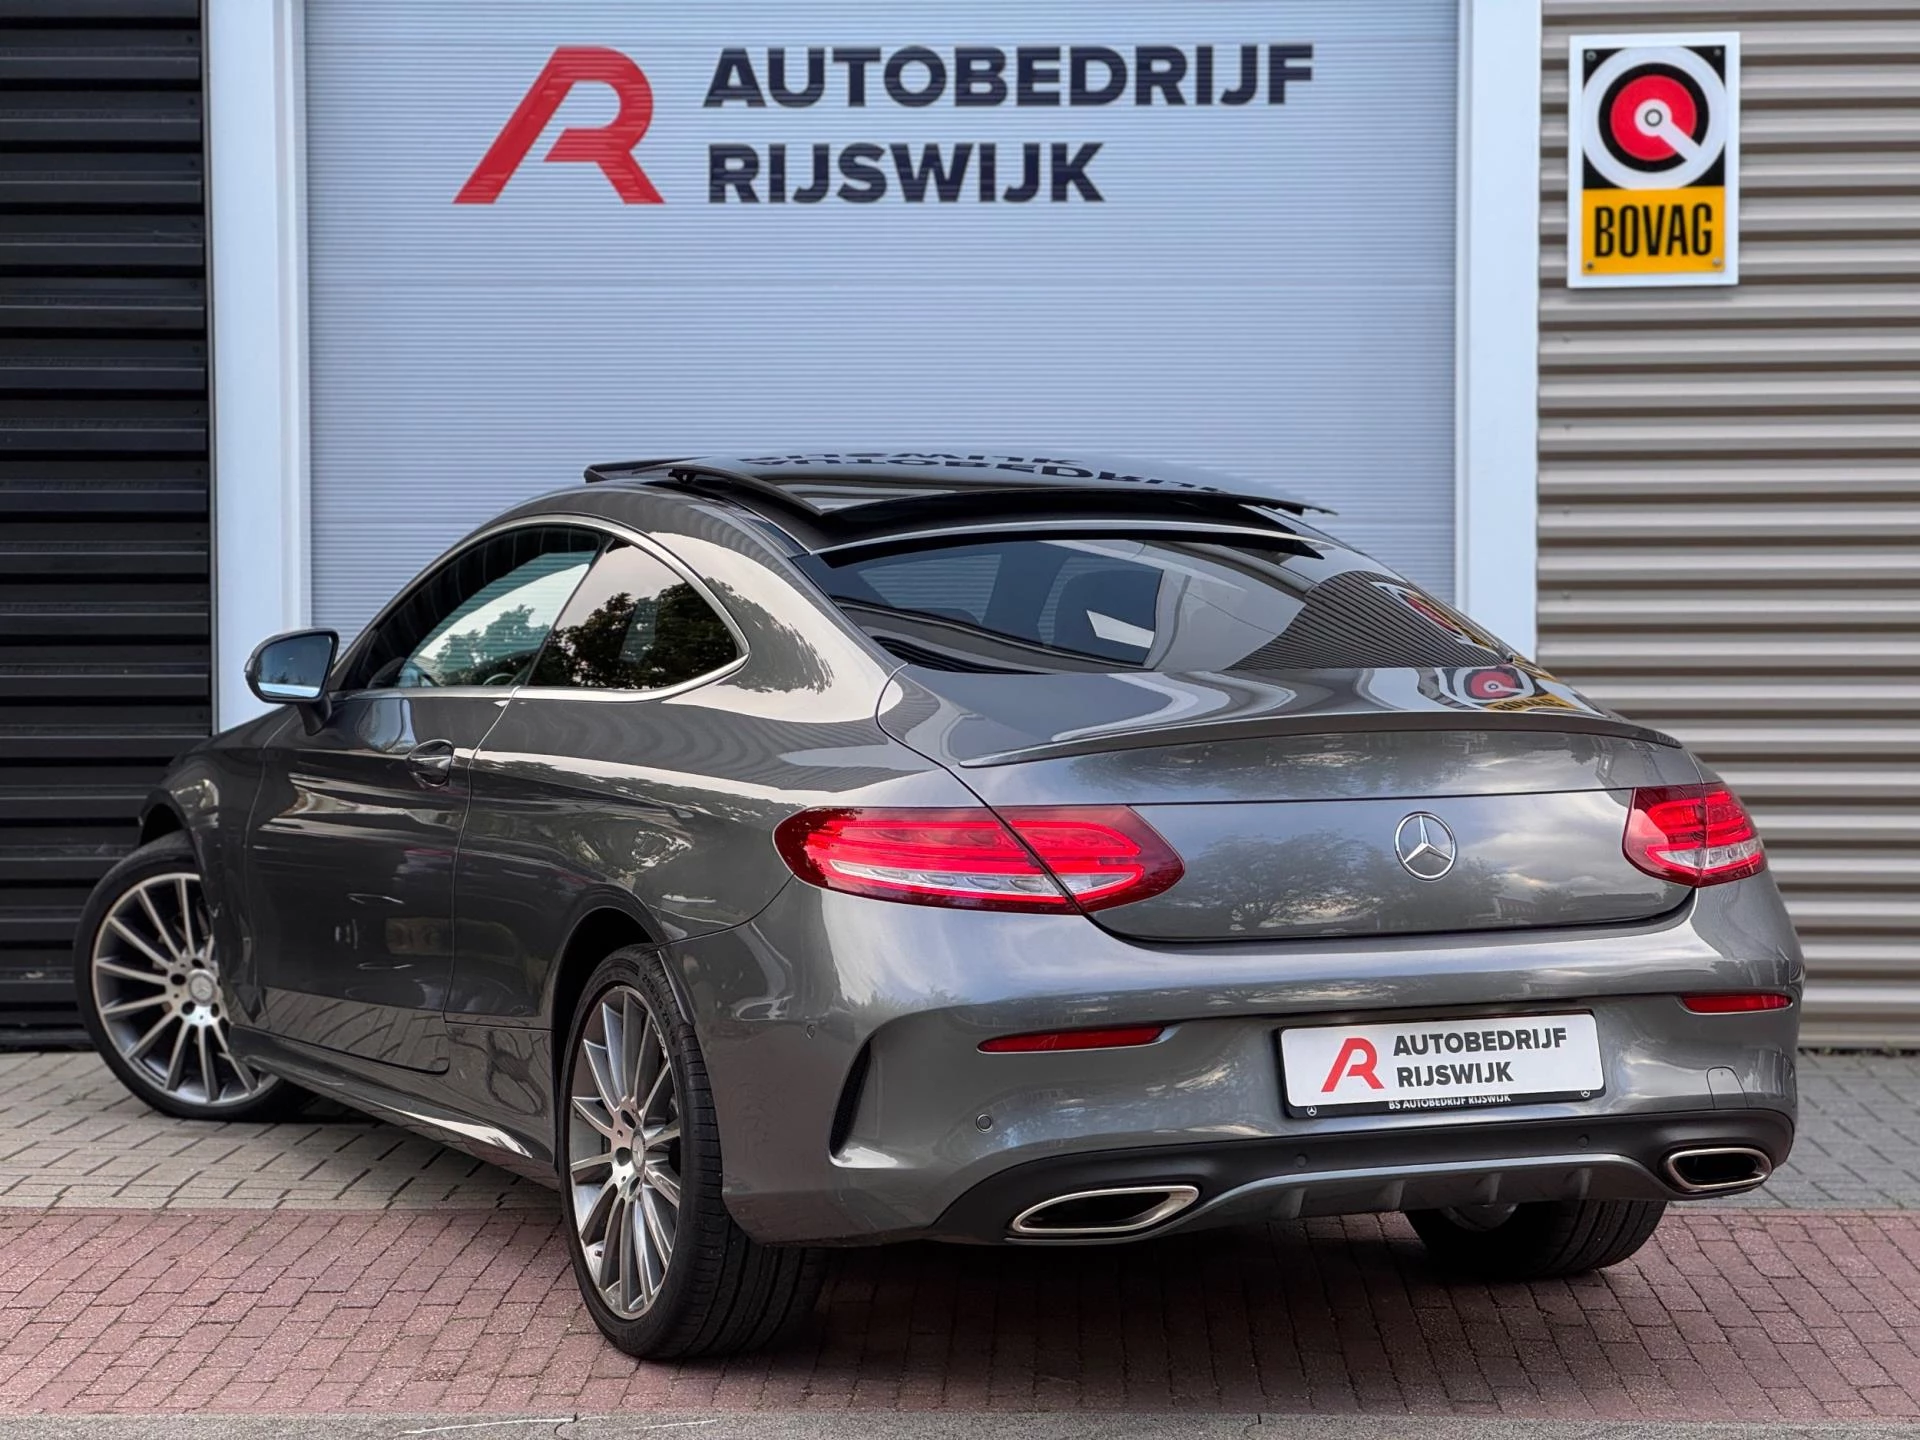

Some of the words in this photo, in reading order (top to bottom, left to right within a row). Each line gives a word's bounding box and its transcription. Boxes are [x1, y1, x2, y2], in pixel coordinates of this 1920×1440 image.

[703, 44, 1313, 107] AUTOBEDRIJF
[709, 142, 1104, 203] RIJSWIJK
[1594, 202, 1713, 258] BOVAG
[1393, 1027, 1567, 1056] AUTOBEDRIJF
[1397, 1062, 1514, 1088] RIJSWIJK
[1388, 1101, 1401, 1110] BS
[1403, 1096, 1466, 1109] AUTOBEDRIJF
[1468, 1094, 1512, 1105] RIJSWIJK
